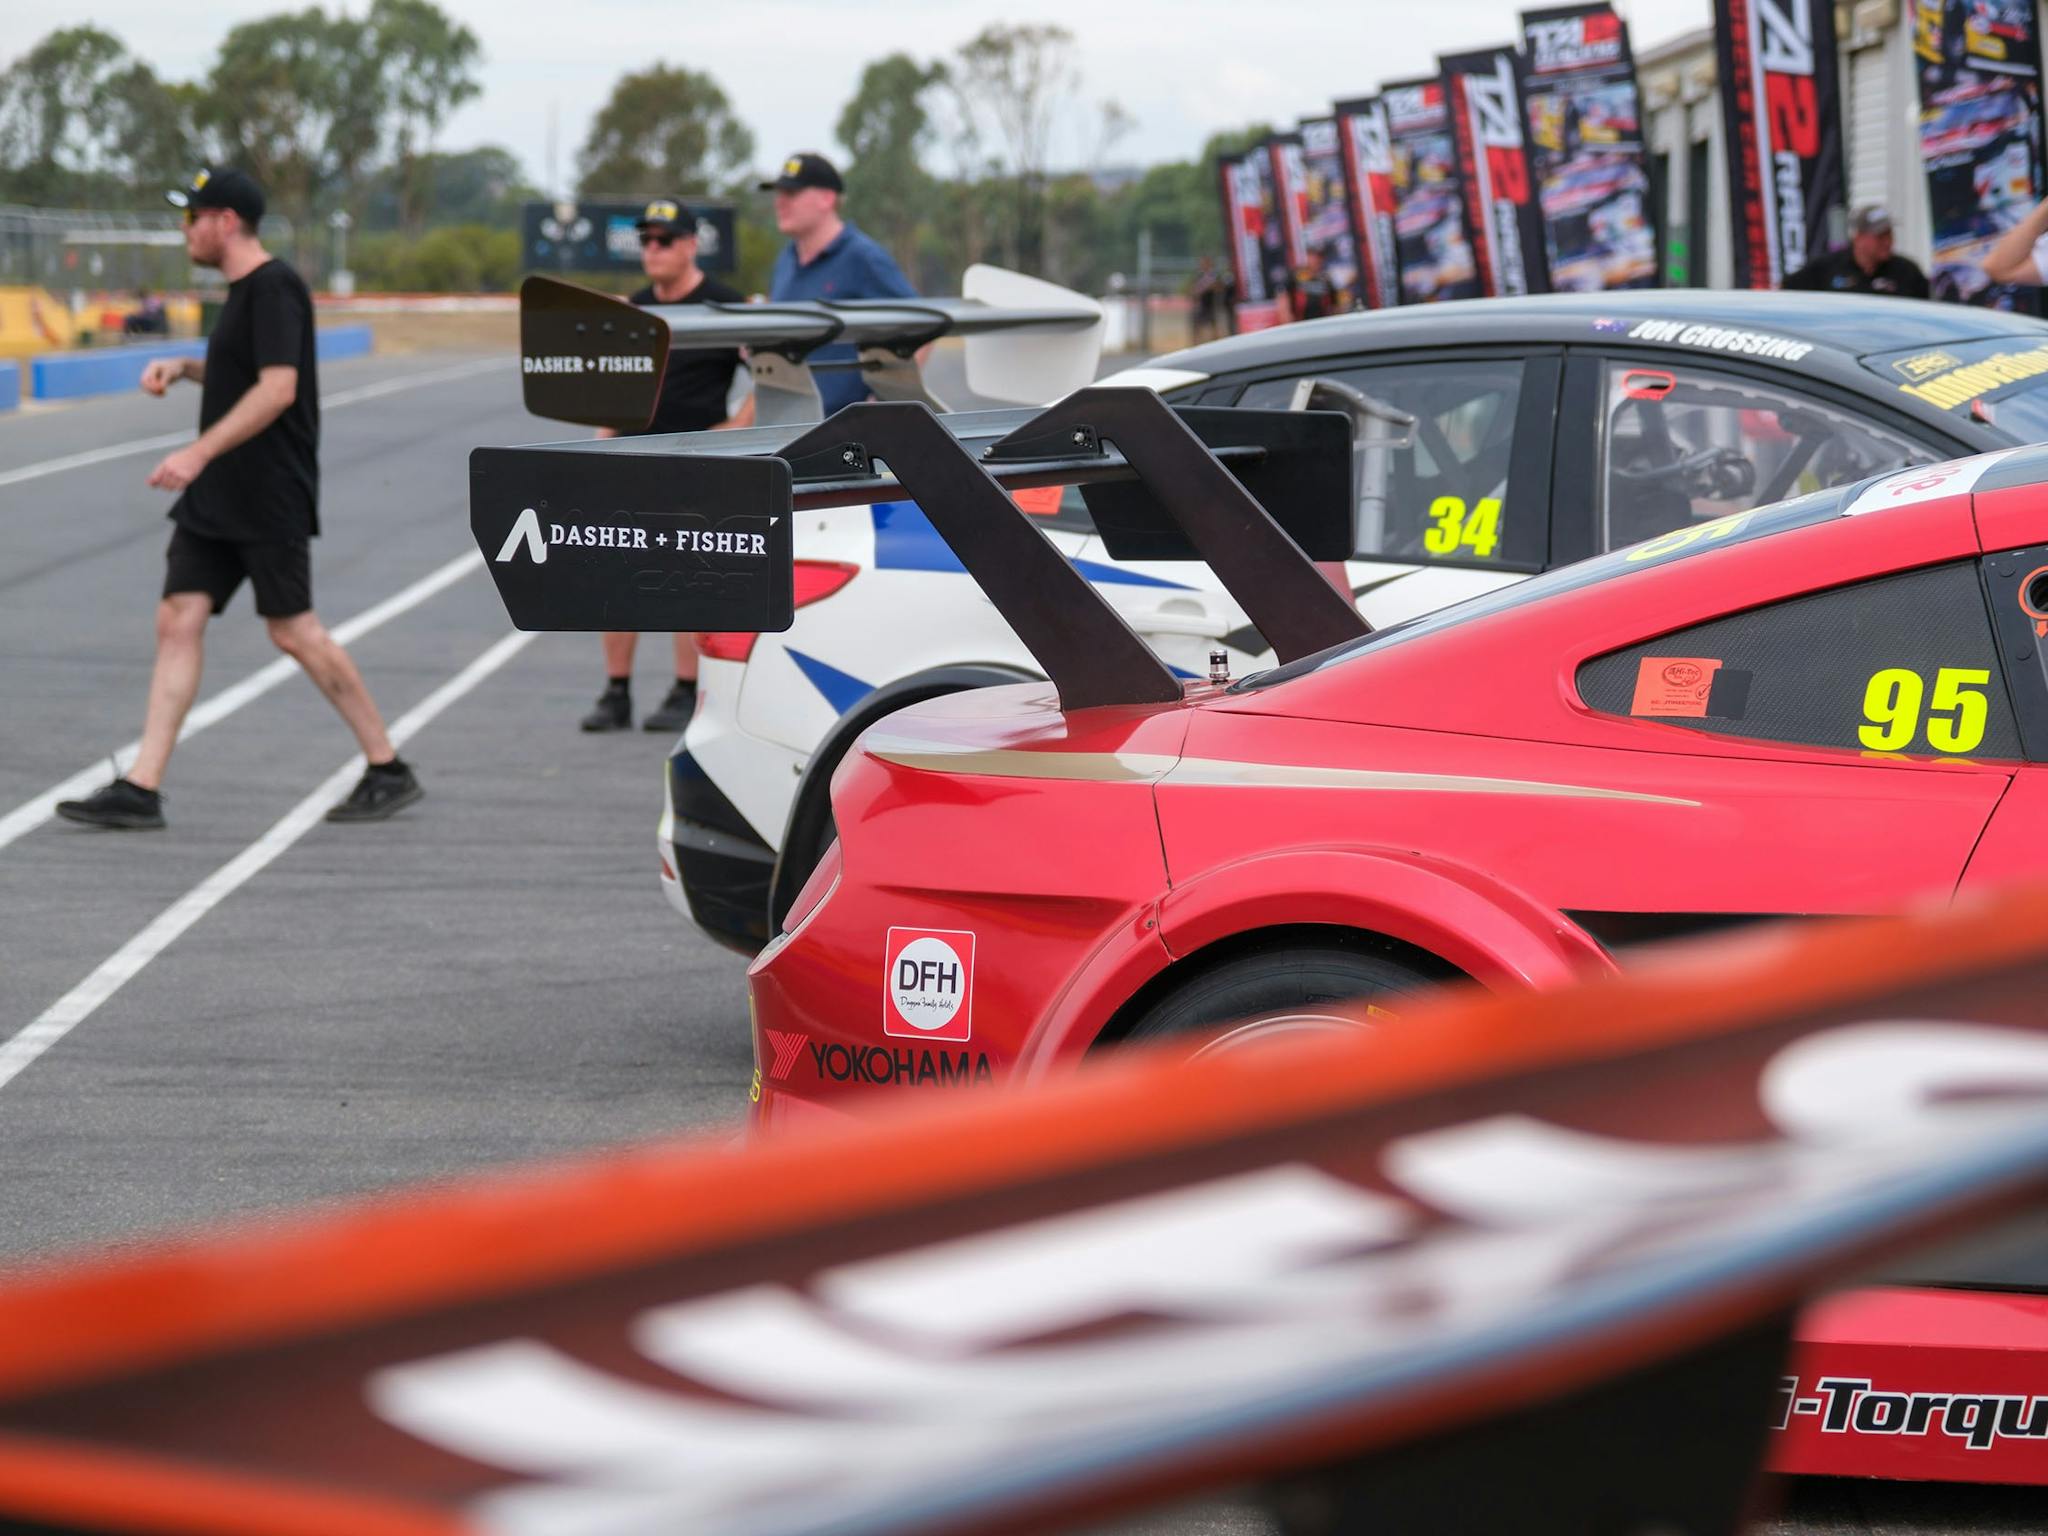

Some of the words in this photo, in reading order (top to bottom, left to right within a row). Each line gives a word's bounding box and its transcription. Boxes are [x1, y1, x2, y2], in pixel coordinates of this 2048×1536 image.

[1628, 319, 1686, 343] JON
[1678, 325, 1815, 362] CROSSING
[523, 357, 583, 373] DASHER
[586, 359, 596, 370] +
[599, 356, 654, 373] FISHER
[550, 523, 648, 549] DASHER
[656, 533, 668, 546] +
[676, 530, 767, 555] FISHER
[1424, 496, 1502, 556] 34
[1858, 667, 1991, 753] 95
[899, 959, 957, 994] DFH
[809, 1042, 995, 1089] YOKOHAMA
